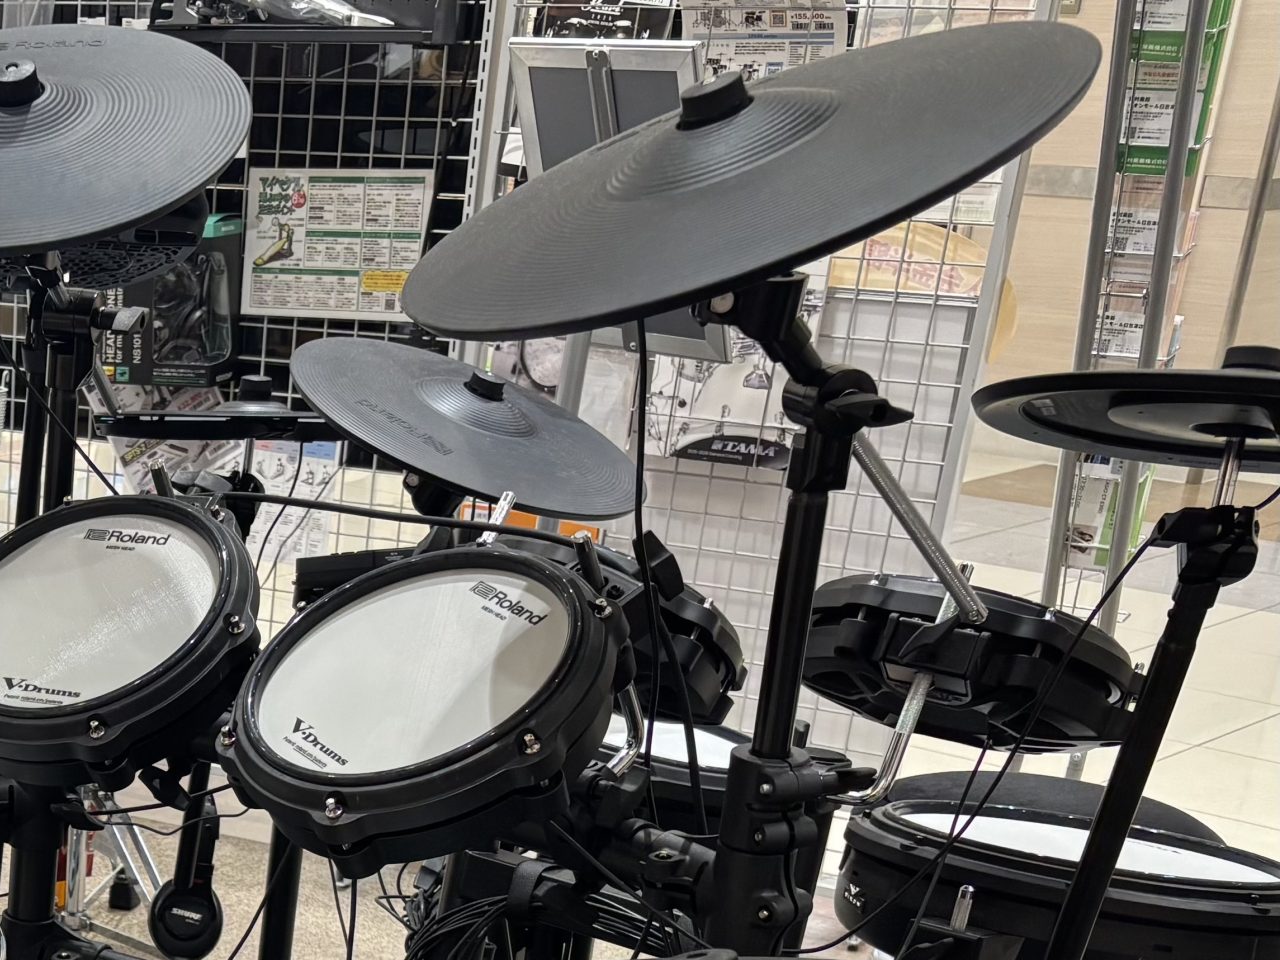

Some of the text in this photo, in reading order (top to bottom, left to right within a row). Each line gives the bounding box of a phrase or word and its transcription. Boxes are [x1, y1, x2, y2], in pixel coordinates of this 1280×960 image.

[723, 441, 776, 457] TAMA
[108, 530, 171, 546] Roland
[490, 590, 549, 626] Roland
